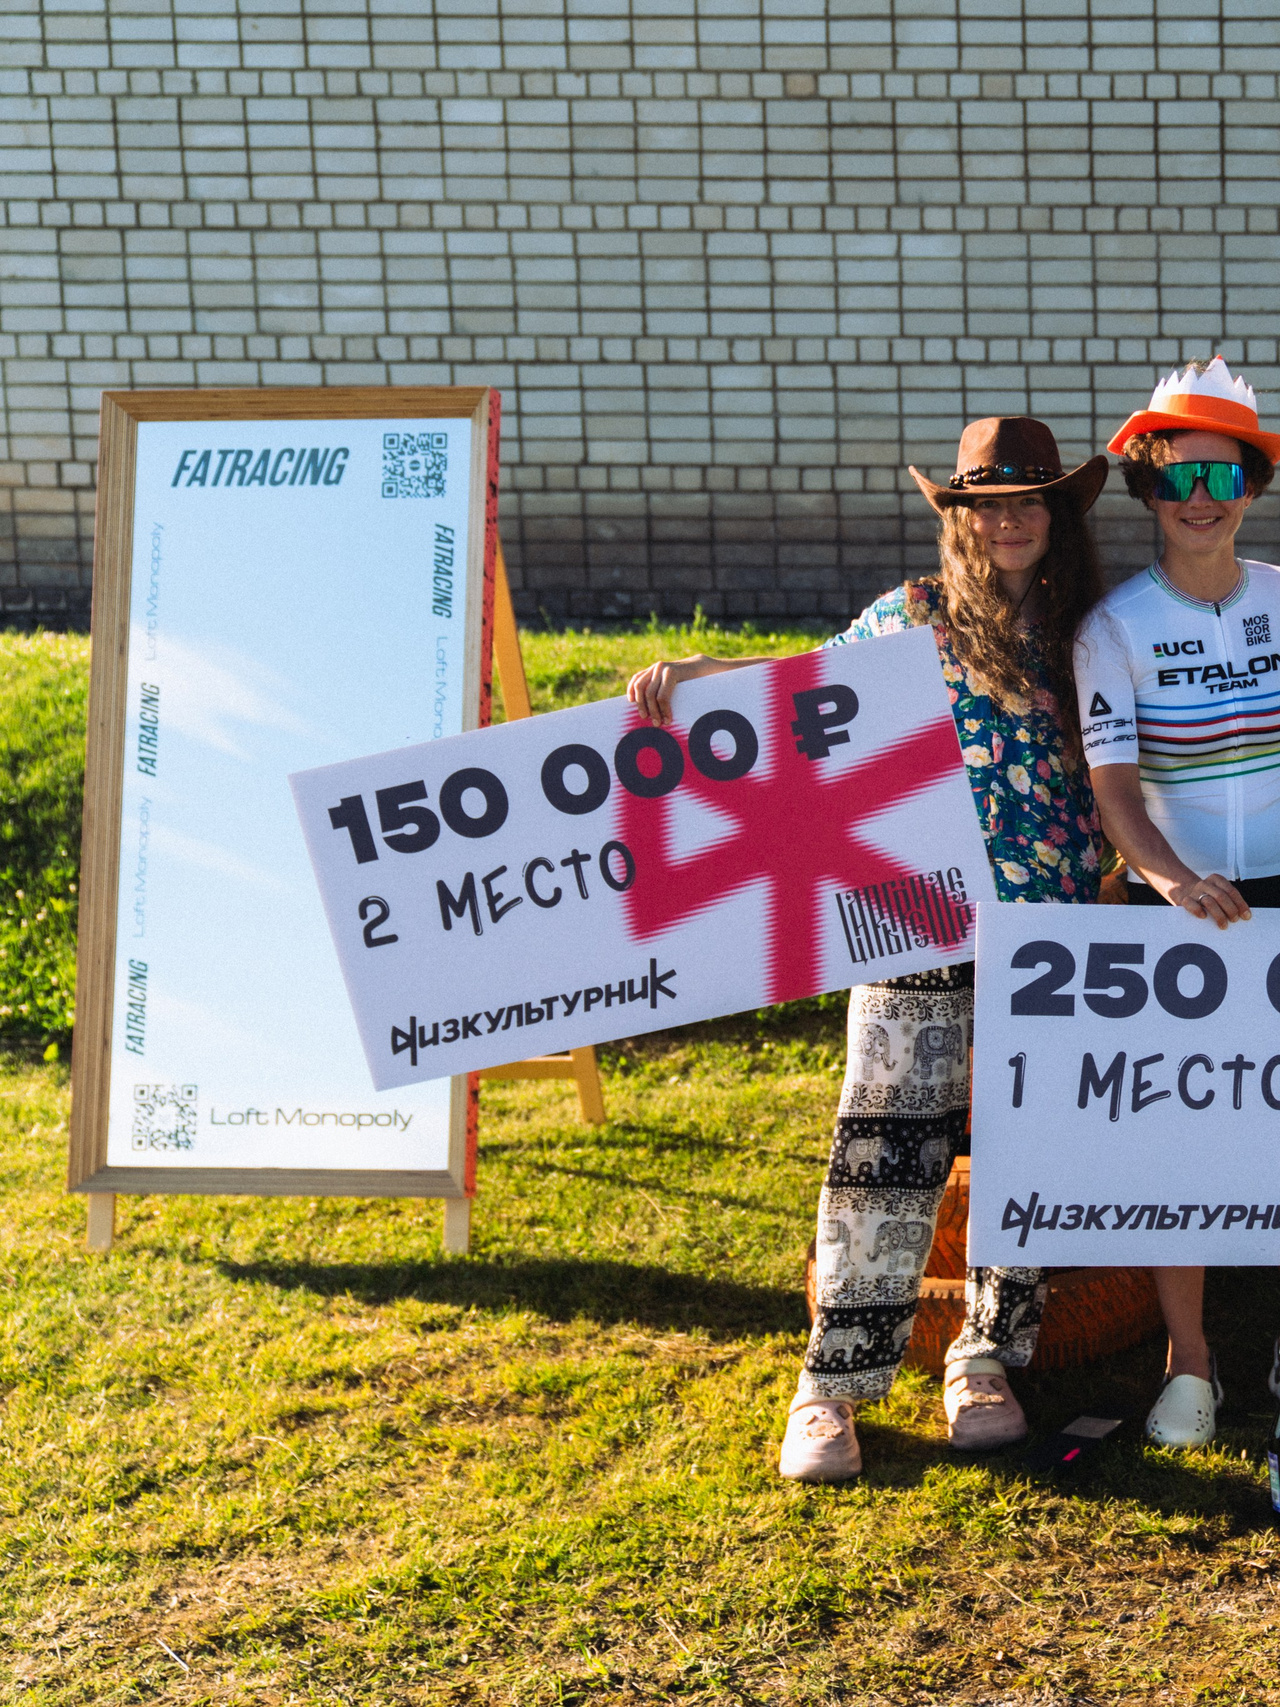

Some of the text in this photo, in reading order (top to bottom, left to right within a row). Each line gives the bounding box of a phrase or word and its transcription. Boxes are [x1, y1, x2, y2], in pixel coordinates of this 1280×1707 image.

[170, 447, 350, 488] FATRACING
[145, 521, 164, 661] Loft Monopoly
[432, 523, 455, 619] FATRACING
[1162, 639, 1205, 657] UCI
[1242, 614, 1269, 628] MOS
[1245, 624, 1270, 638] GOR
[1246, 633, 1272, 647] BIKE
[432, 636, 448, 739] Loft Mono
[1205, 678, 1258, 695] TEAM
[137, 682, 159, 777] FATRACING
[328, 767, 510, 864] 150
[540, 709, 758, 815] 000
[132, 796, 152, 938] Loft Monopoly
[357, 840, 636, 948] 2 МЕСТО
[125, 959, 148, 1055] FATRACING
[1010, 940, 1228, 1020] 250
[210, 1108, 413, 1132] Loft Monopoly
[1008, 1051, 1027, 1109] 1
